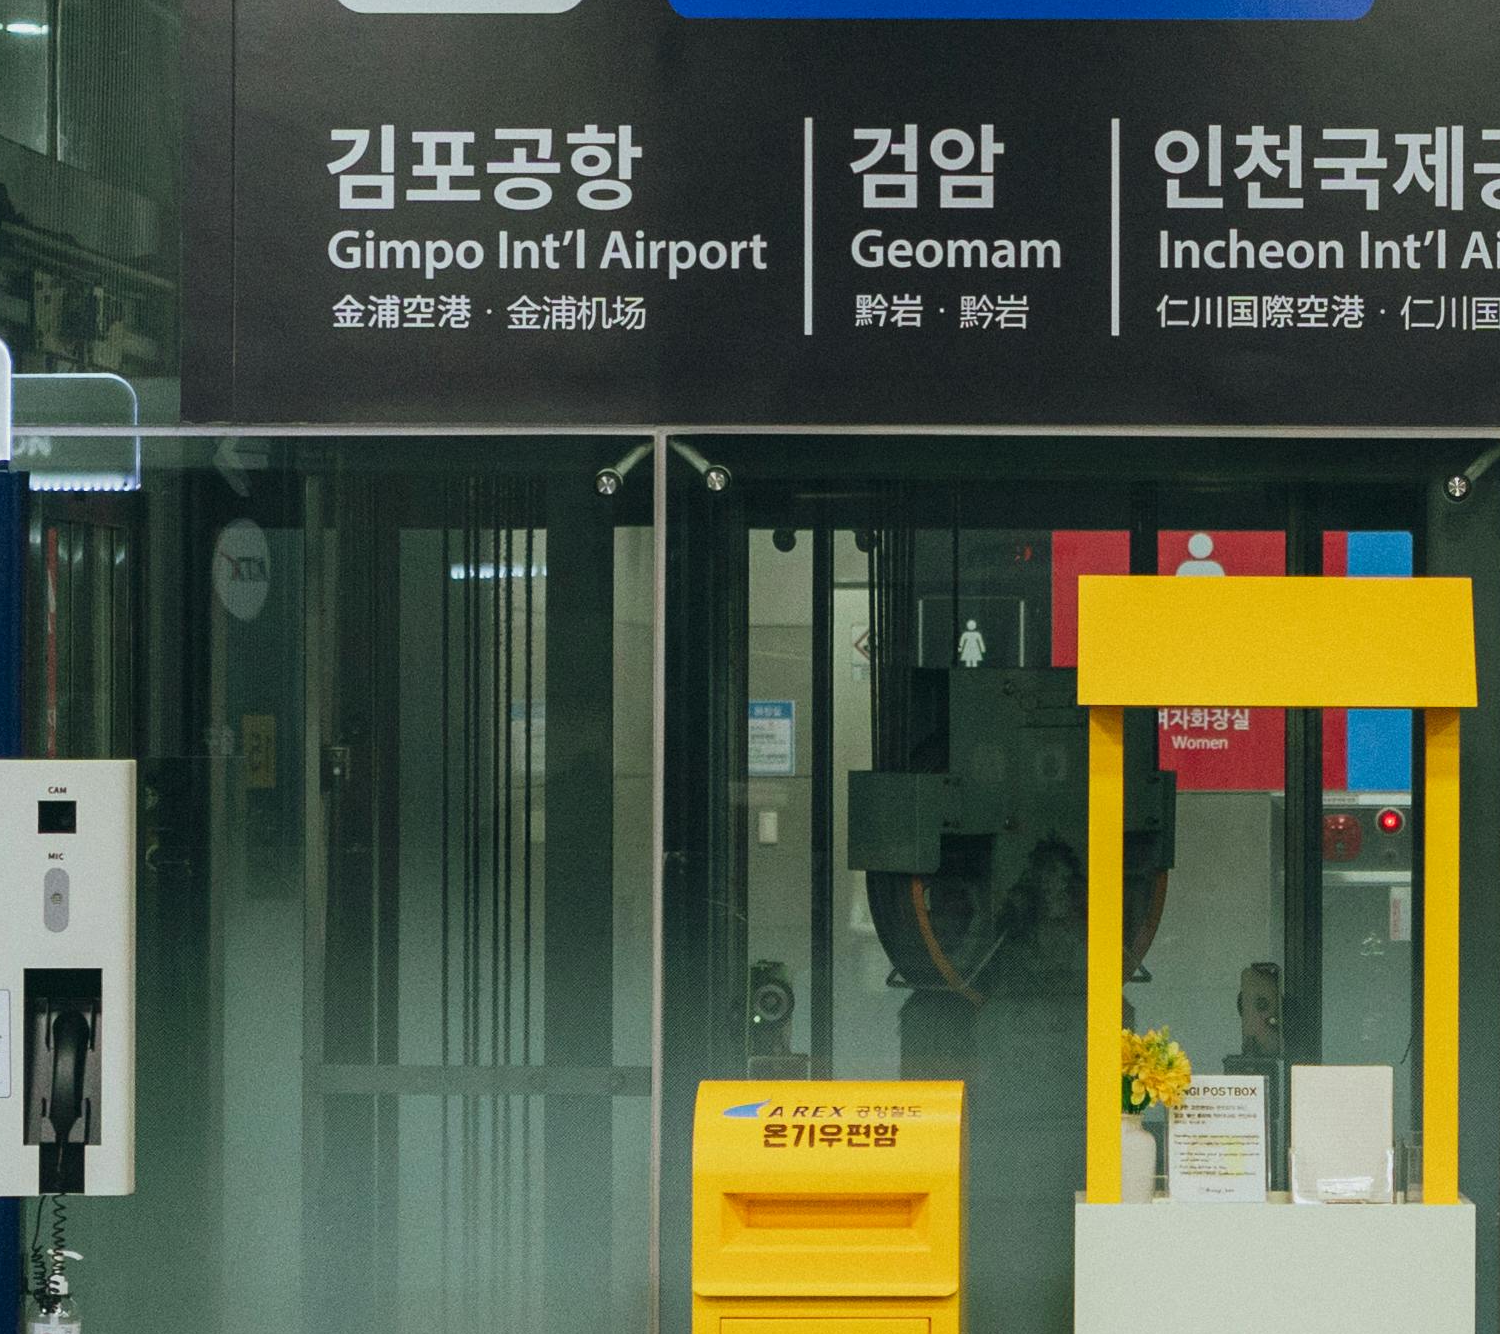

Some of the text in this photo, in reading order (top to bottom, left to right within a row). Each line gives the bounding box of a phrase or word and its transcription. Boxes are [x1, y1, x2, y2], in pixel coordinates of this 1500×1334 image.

[326, 123, 643, 212] 김포공항
[849, 123, 1005, 210] 검암
[327, 229, 485, 281] Gimpo
[600, 229, 768, 281] Airport
[851, 229, 1062, 270] Geomam
[1160, 228, 1345, 270] Incheon
[332, 294, 647, 331] 金浦空港 金浦机场
[855, 293, 1029, 330] 黔岩 黔岩
[1156, 294, 1365, 330] 仁川国際空港
[1158, 707, 1250, 731] 여자화장실
[1171, 735, 1229, 750] Women
[48, 786, 67, 794] CAM
[48, 852, 64, 860] MIC
[1203, 1087, 1257, 1097] POSTBOX
[856, 1105, 922, 1118] 공항철도
[763, 1123, 899, 1148] 온기우편함
